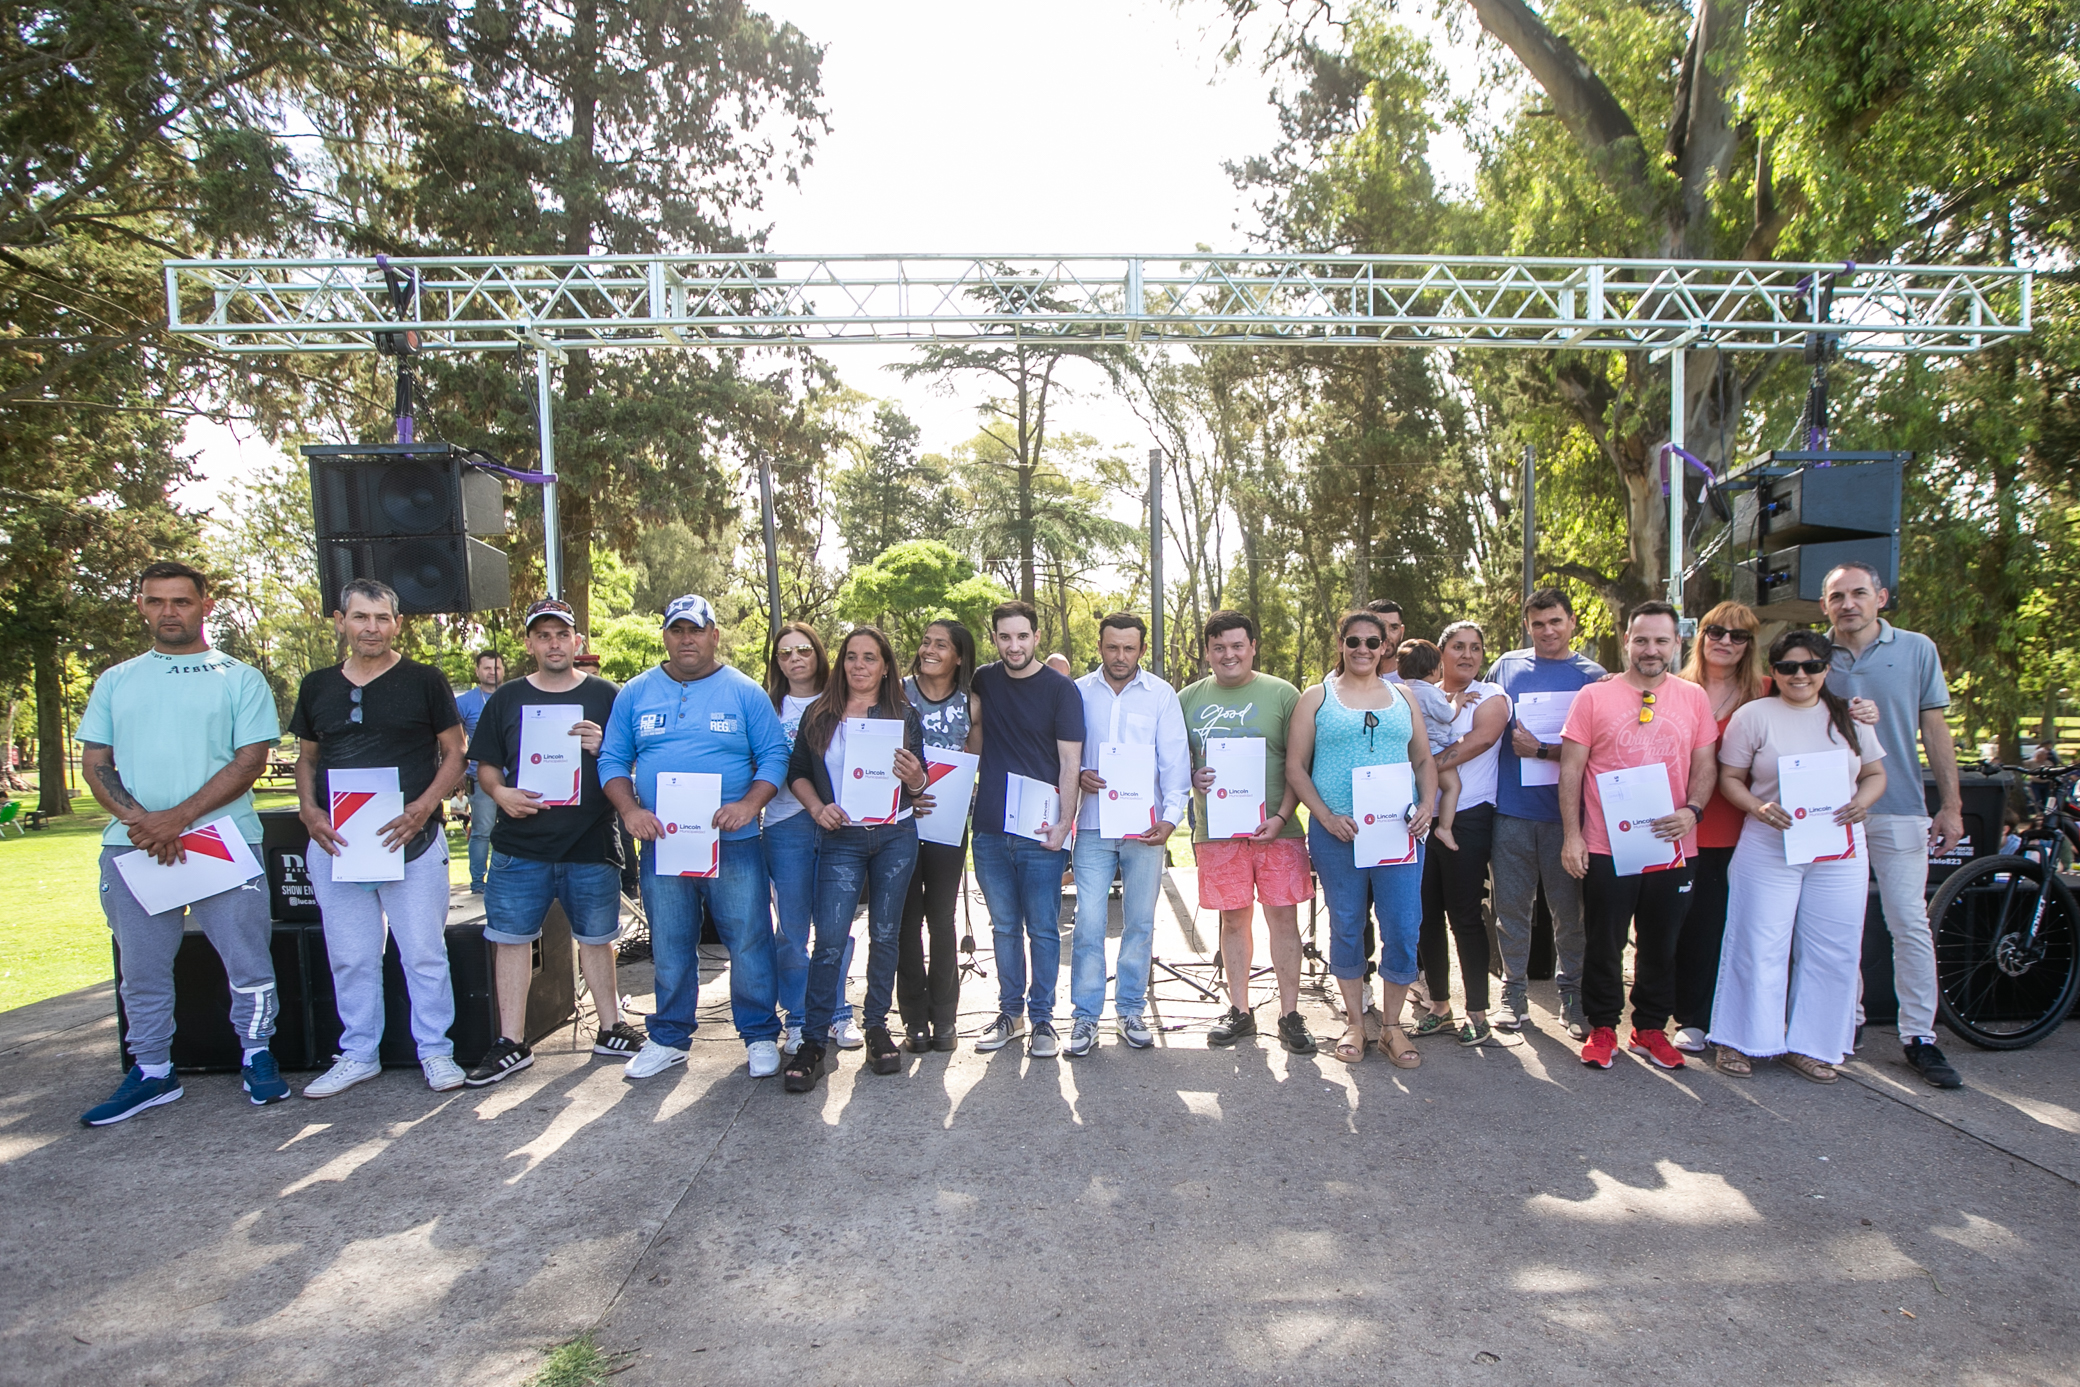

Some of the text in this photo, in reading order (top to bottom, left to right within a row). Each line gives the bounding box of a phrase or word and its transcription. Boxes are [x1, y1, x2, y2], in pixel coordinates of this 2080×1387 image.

[1808, 805, 1832, 813] Lincoln
[1928, 857, 1962, 865] ablo823
[281, 885, 303, 895] SHOW
